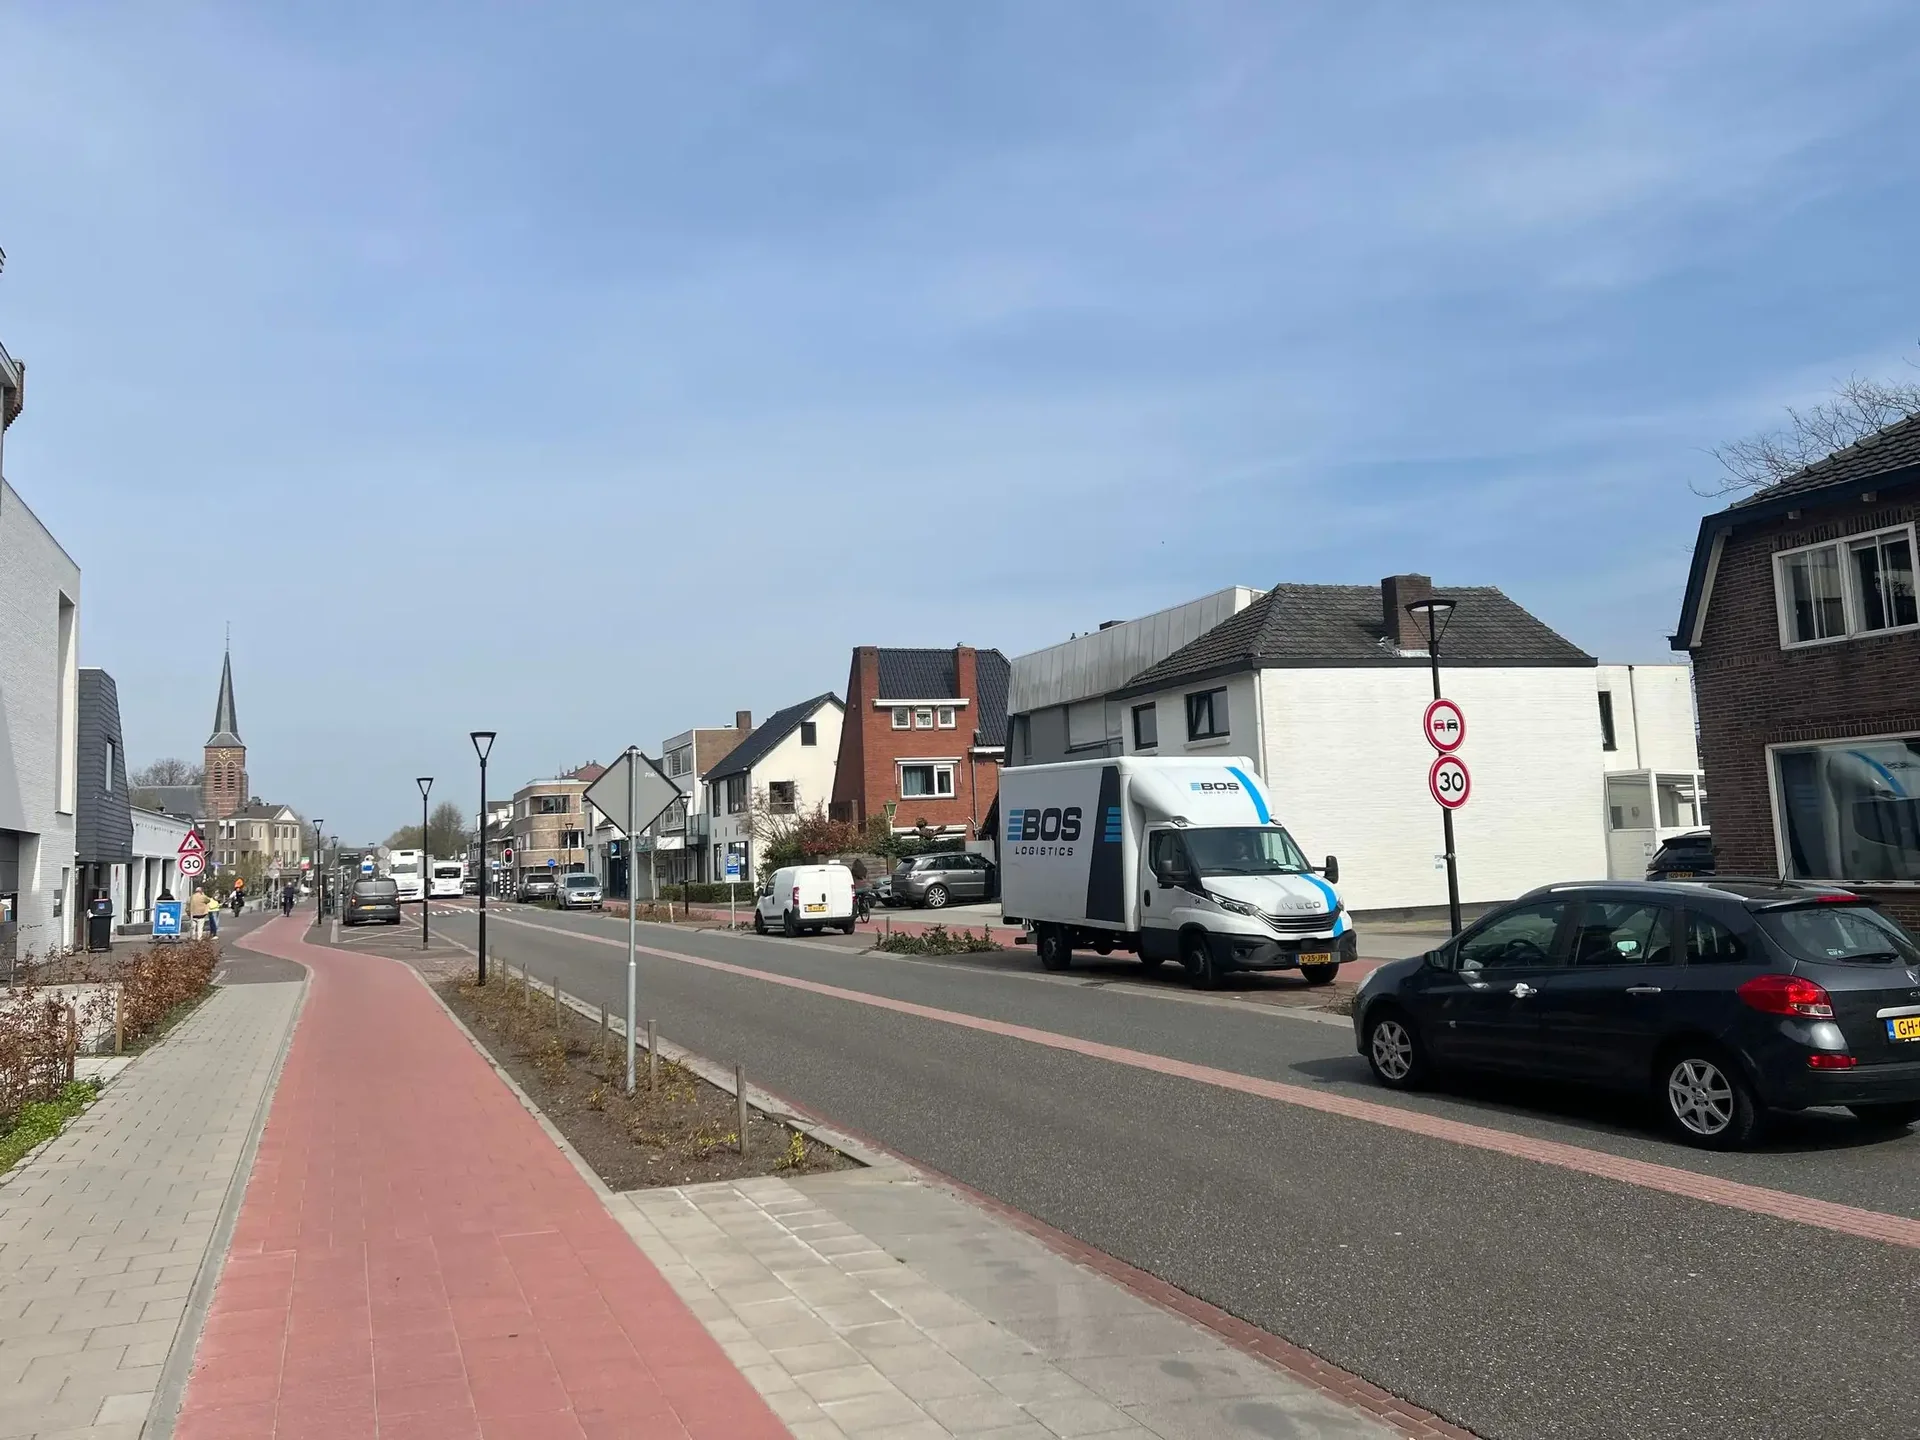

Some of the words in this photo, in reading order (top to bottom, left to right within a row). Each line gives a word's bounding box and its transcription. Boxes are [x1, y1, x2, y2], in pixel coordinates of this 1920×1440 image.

[1200, 782, 1240, 791] BOS
[1439, 771, 1464, 792] 30
[1021, 806, 1083, 842] BOS
[1015, 846, 1074, 857] LOGISTICS
[184, 859, 201, 869] 30
[1281, 900, 1322, 910] IVECO
[1898, 1018, 1920, 1036] GH-
